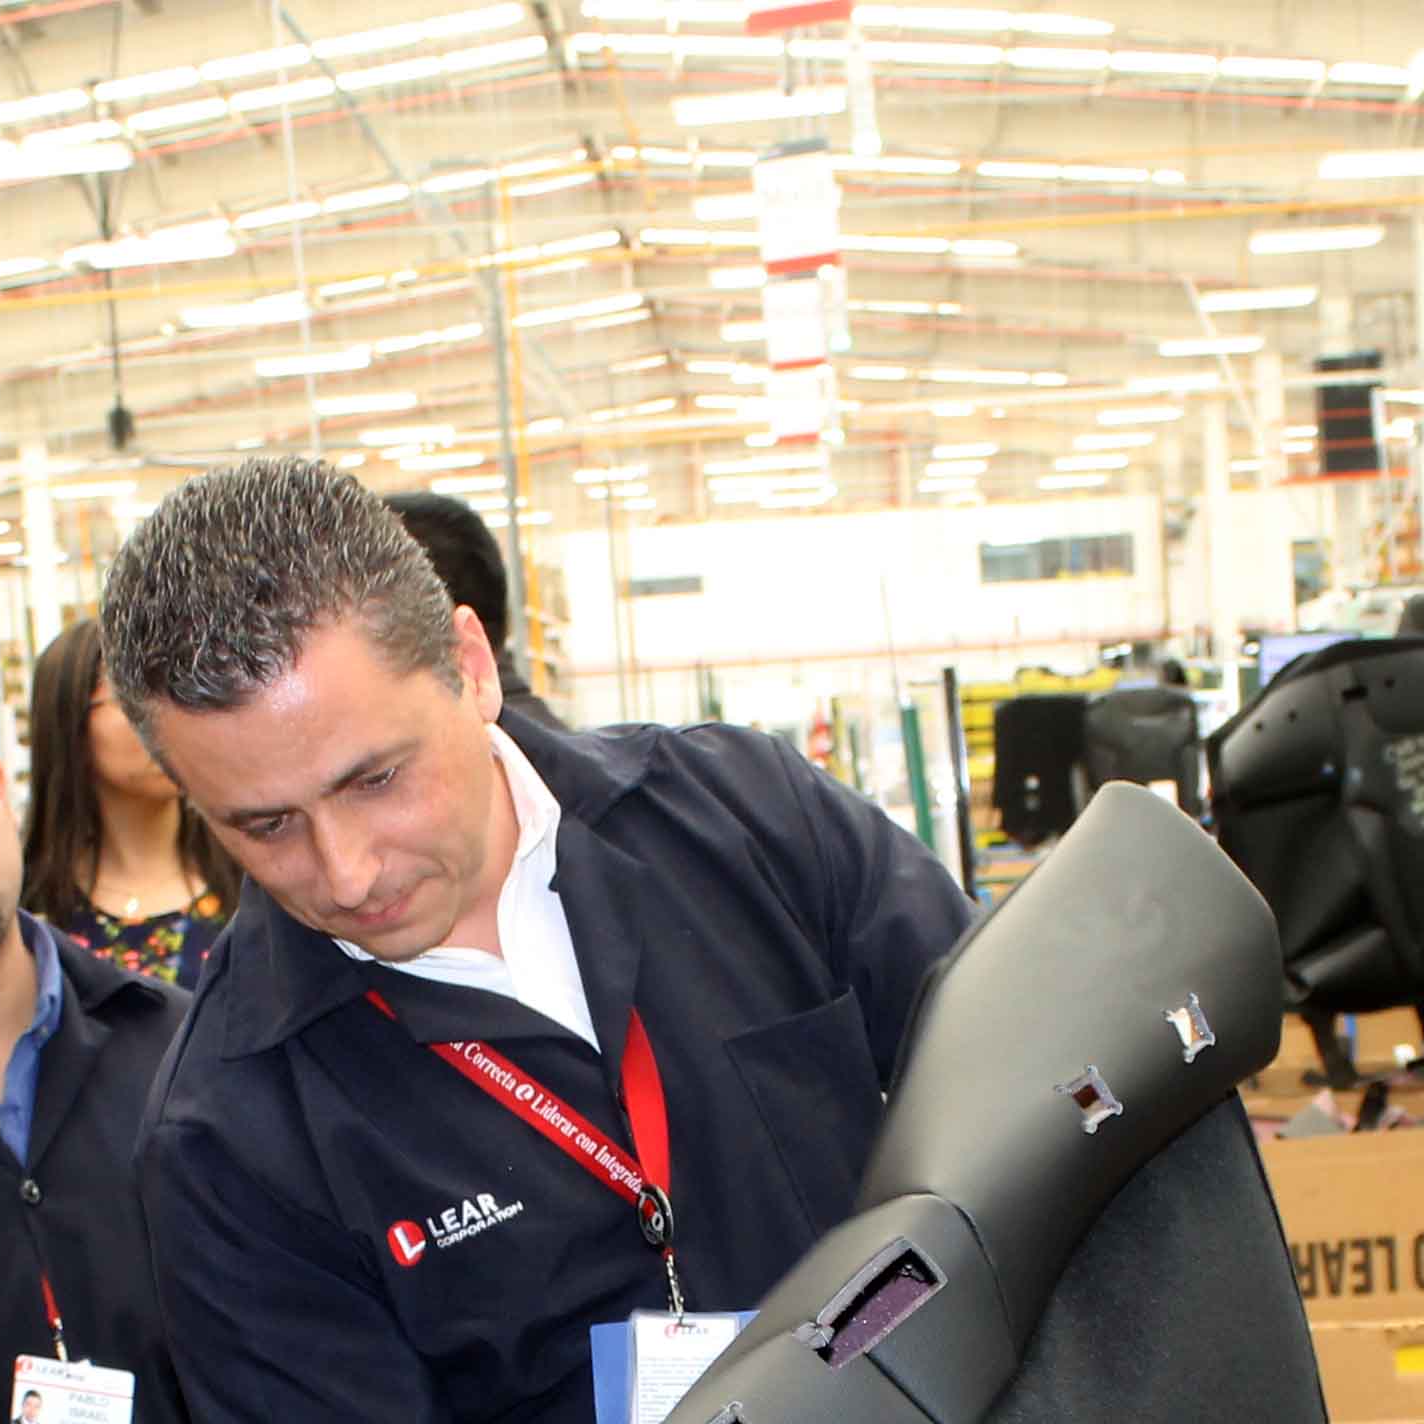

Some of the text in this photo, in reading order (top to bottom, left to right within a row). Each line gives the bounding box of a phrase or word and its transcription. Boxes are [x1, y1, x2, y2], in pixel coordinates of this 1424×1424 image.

[464, 1042, 517, 1091] Correcta
[530, 1093, 579, 1139] Liderar
[575, 1131, 599, 1155] con
[426, 1193, 499, 1238] LEAR
[1290, 1236, 1397, 1300] LEAR
